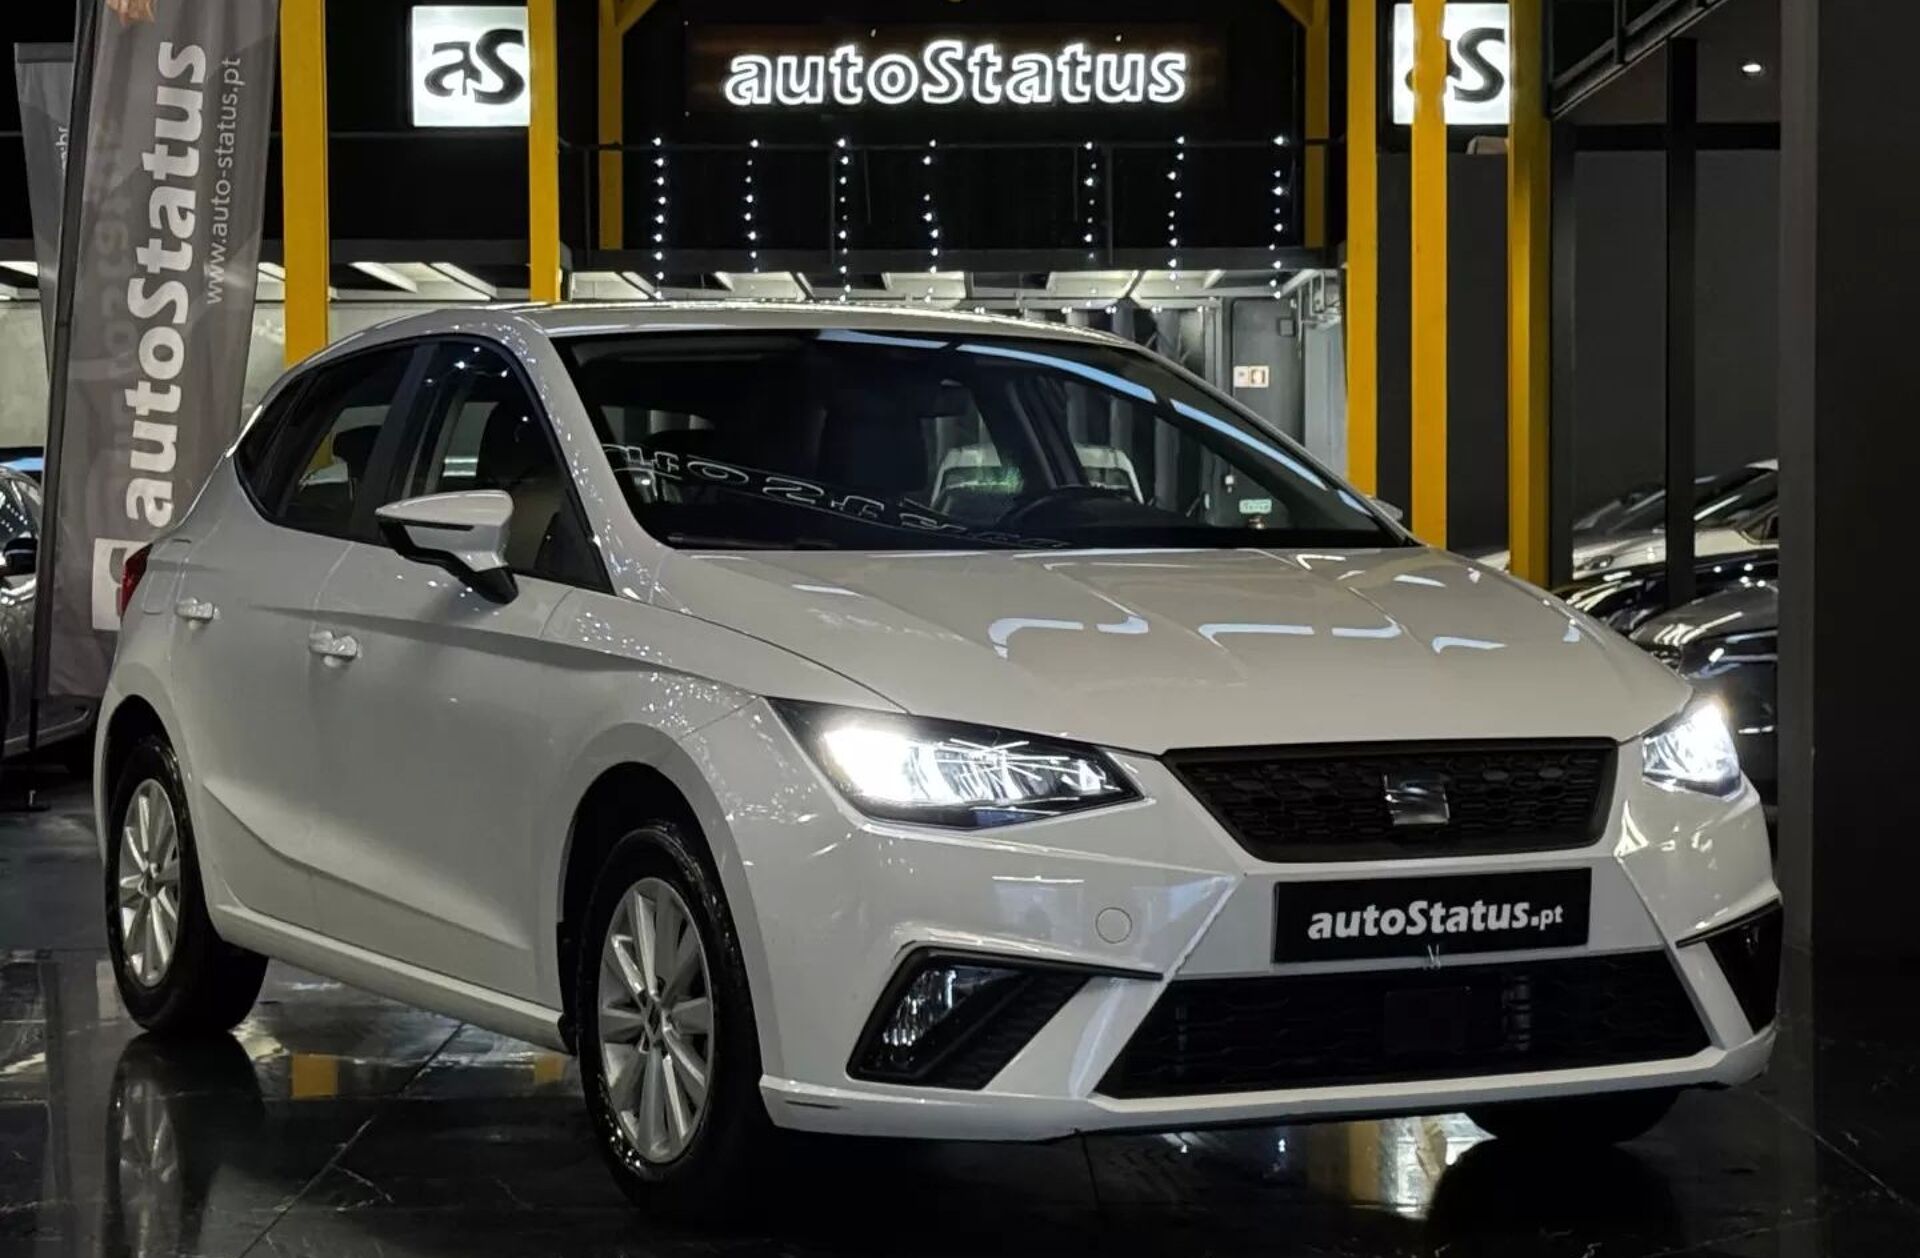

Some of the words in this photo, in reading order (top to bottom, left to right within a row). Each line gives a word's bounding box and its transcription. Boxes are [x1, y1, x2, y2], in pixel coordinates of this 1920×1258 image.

[725, 40, 1187, 106] autoStatus
[206, 57, 245, 304] www.auto-status.pt
[125, 41, 206, 528] autoStatus
[1308, 900, 1563, 940] autoStatus.pt
